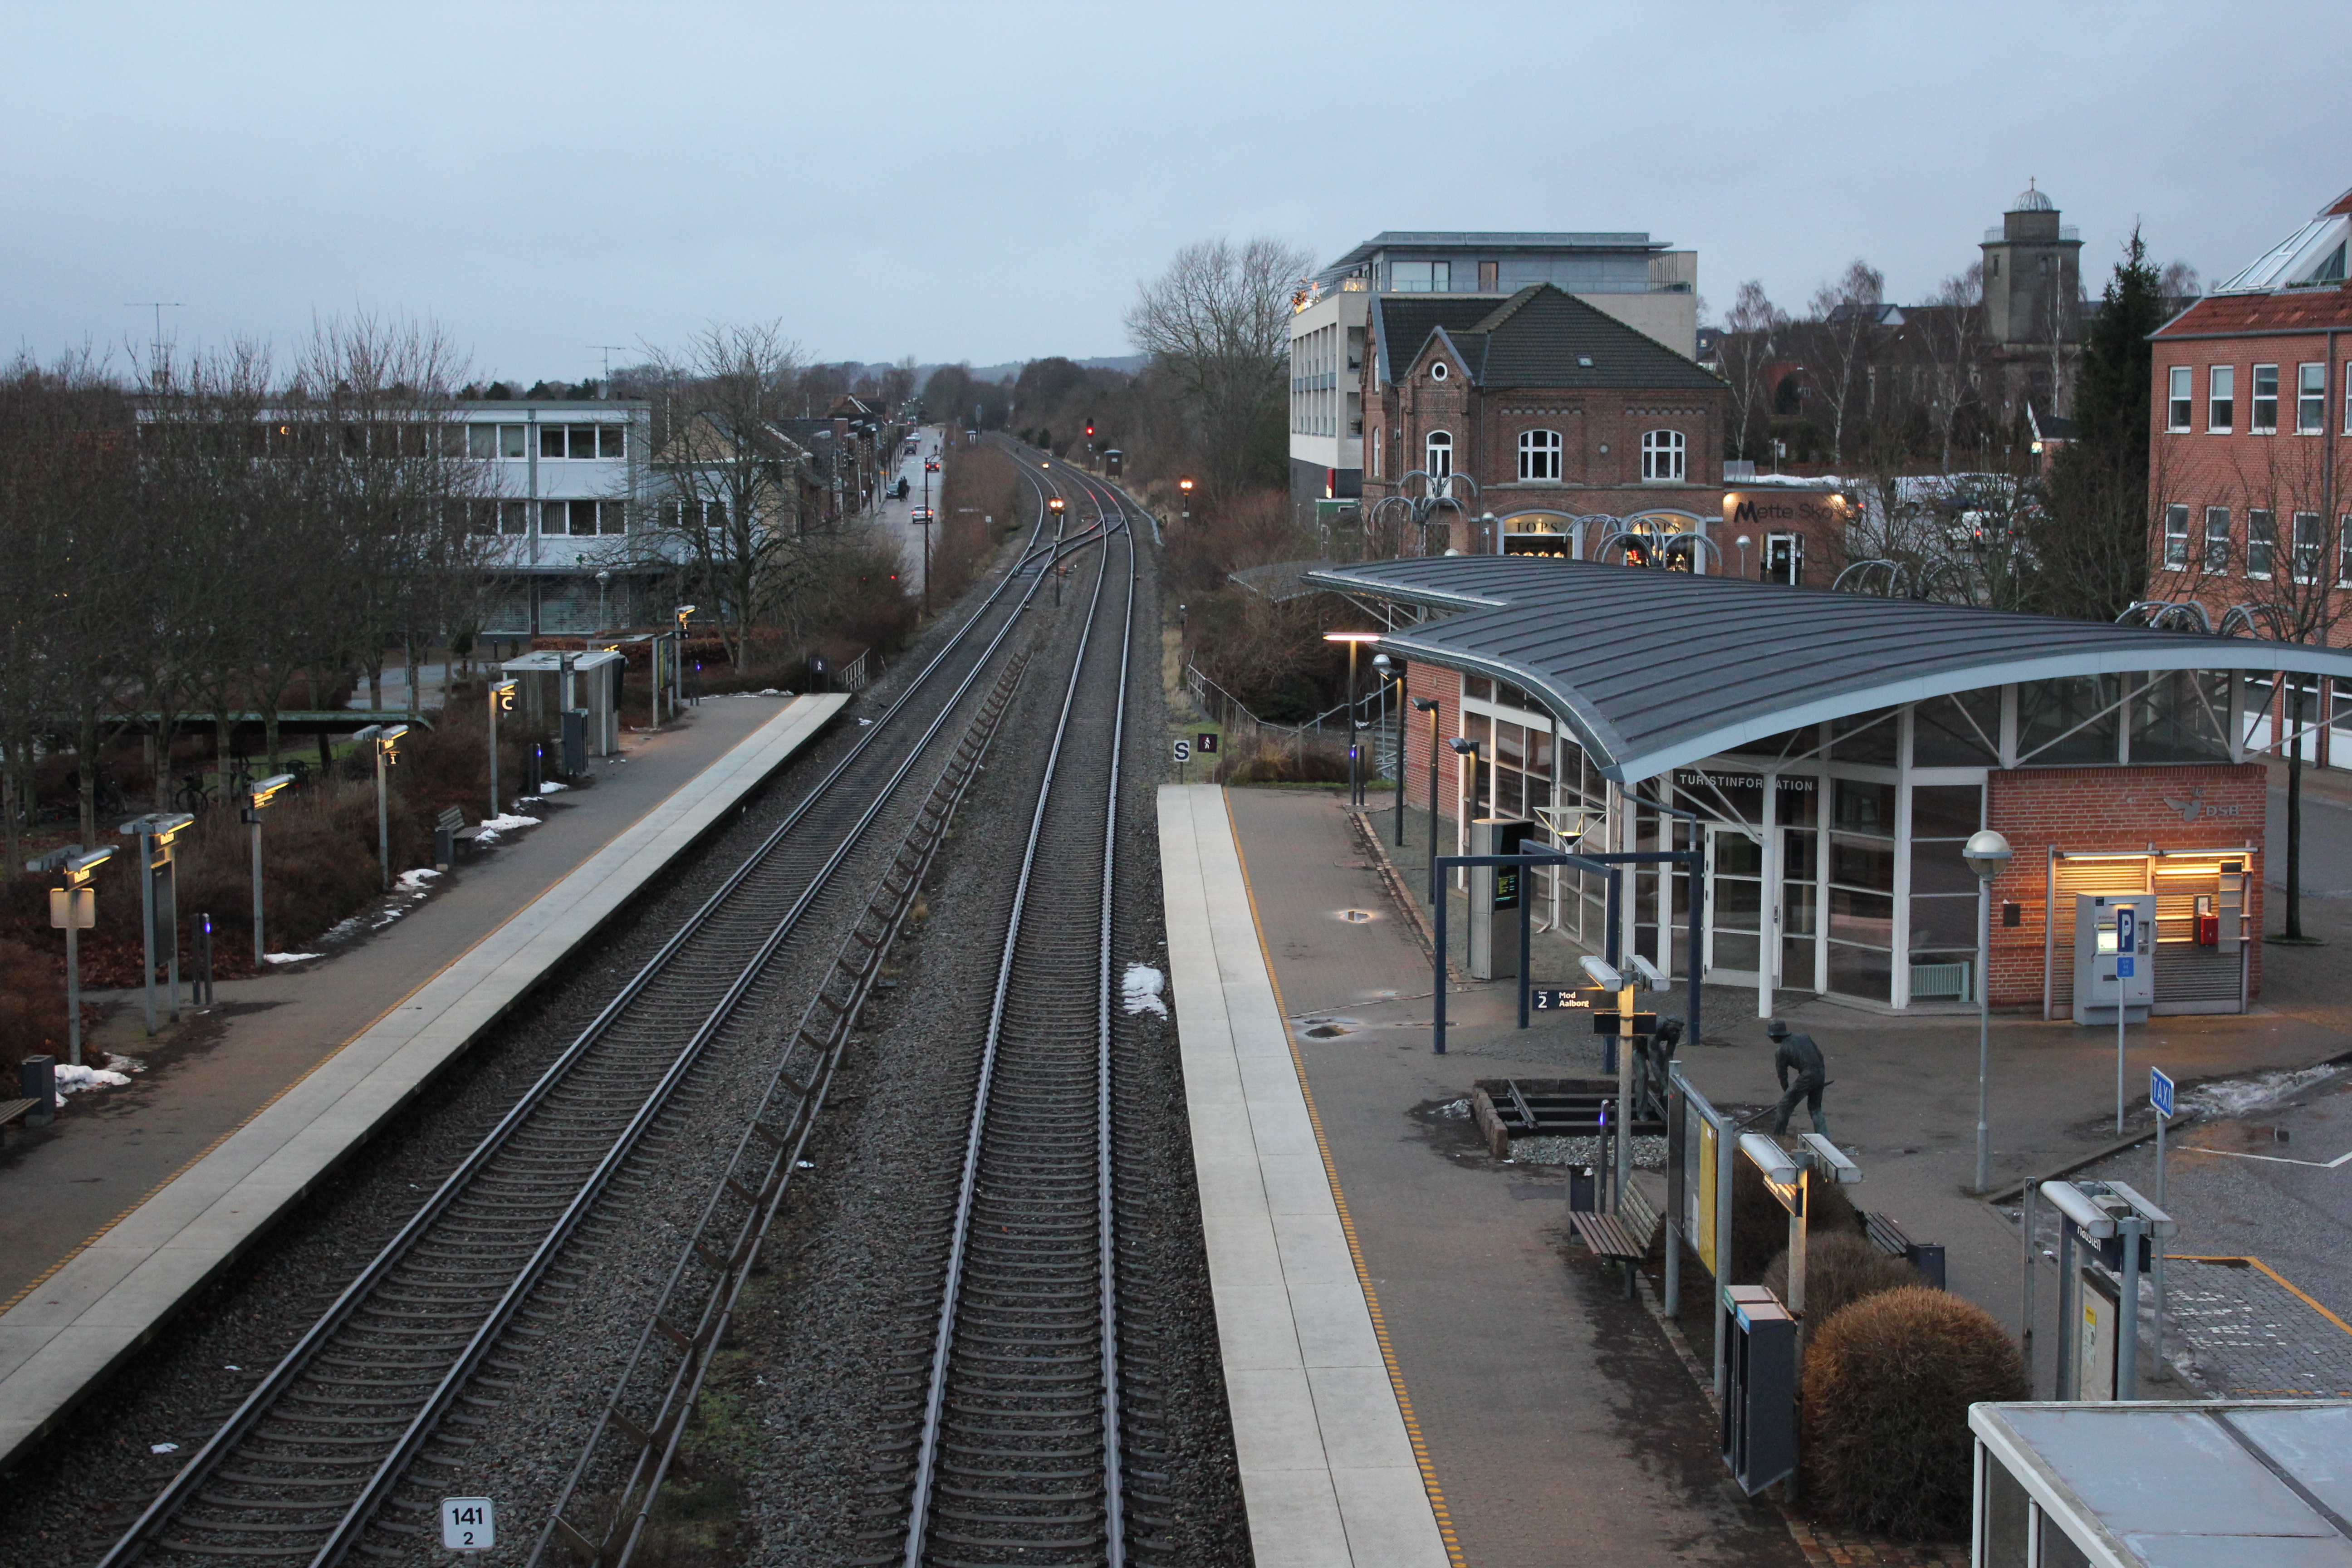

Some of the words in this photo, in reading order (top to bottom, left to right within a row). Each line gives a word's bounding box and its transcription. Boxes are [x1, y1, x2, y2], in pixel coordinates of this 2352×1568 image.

[1734, 500, 1793, 523] Mette
[1799, 503, 1833, 520] Sko
[1515, 523, 1558, 533] TOPS
[501, 696, 513, 710] C
[1175, 742, 1189, 760] S
[1680, 774, 1813, 791] TURSTINFORATION
[2206, 805, 2239, 816] DSB
[2122, 914, 2132, 948] P
[1538, 995, 1548, 1008] 2
[1558, 1000, 1589, 1008] Aalborg
[2153, 1076, 2171, 1110] TAXI
[452, 1507, 483, 1525] 141
[463, 1532, 474, 1545] 2
